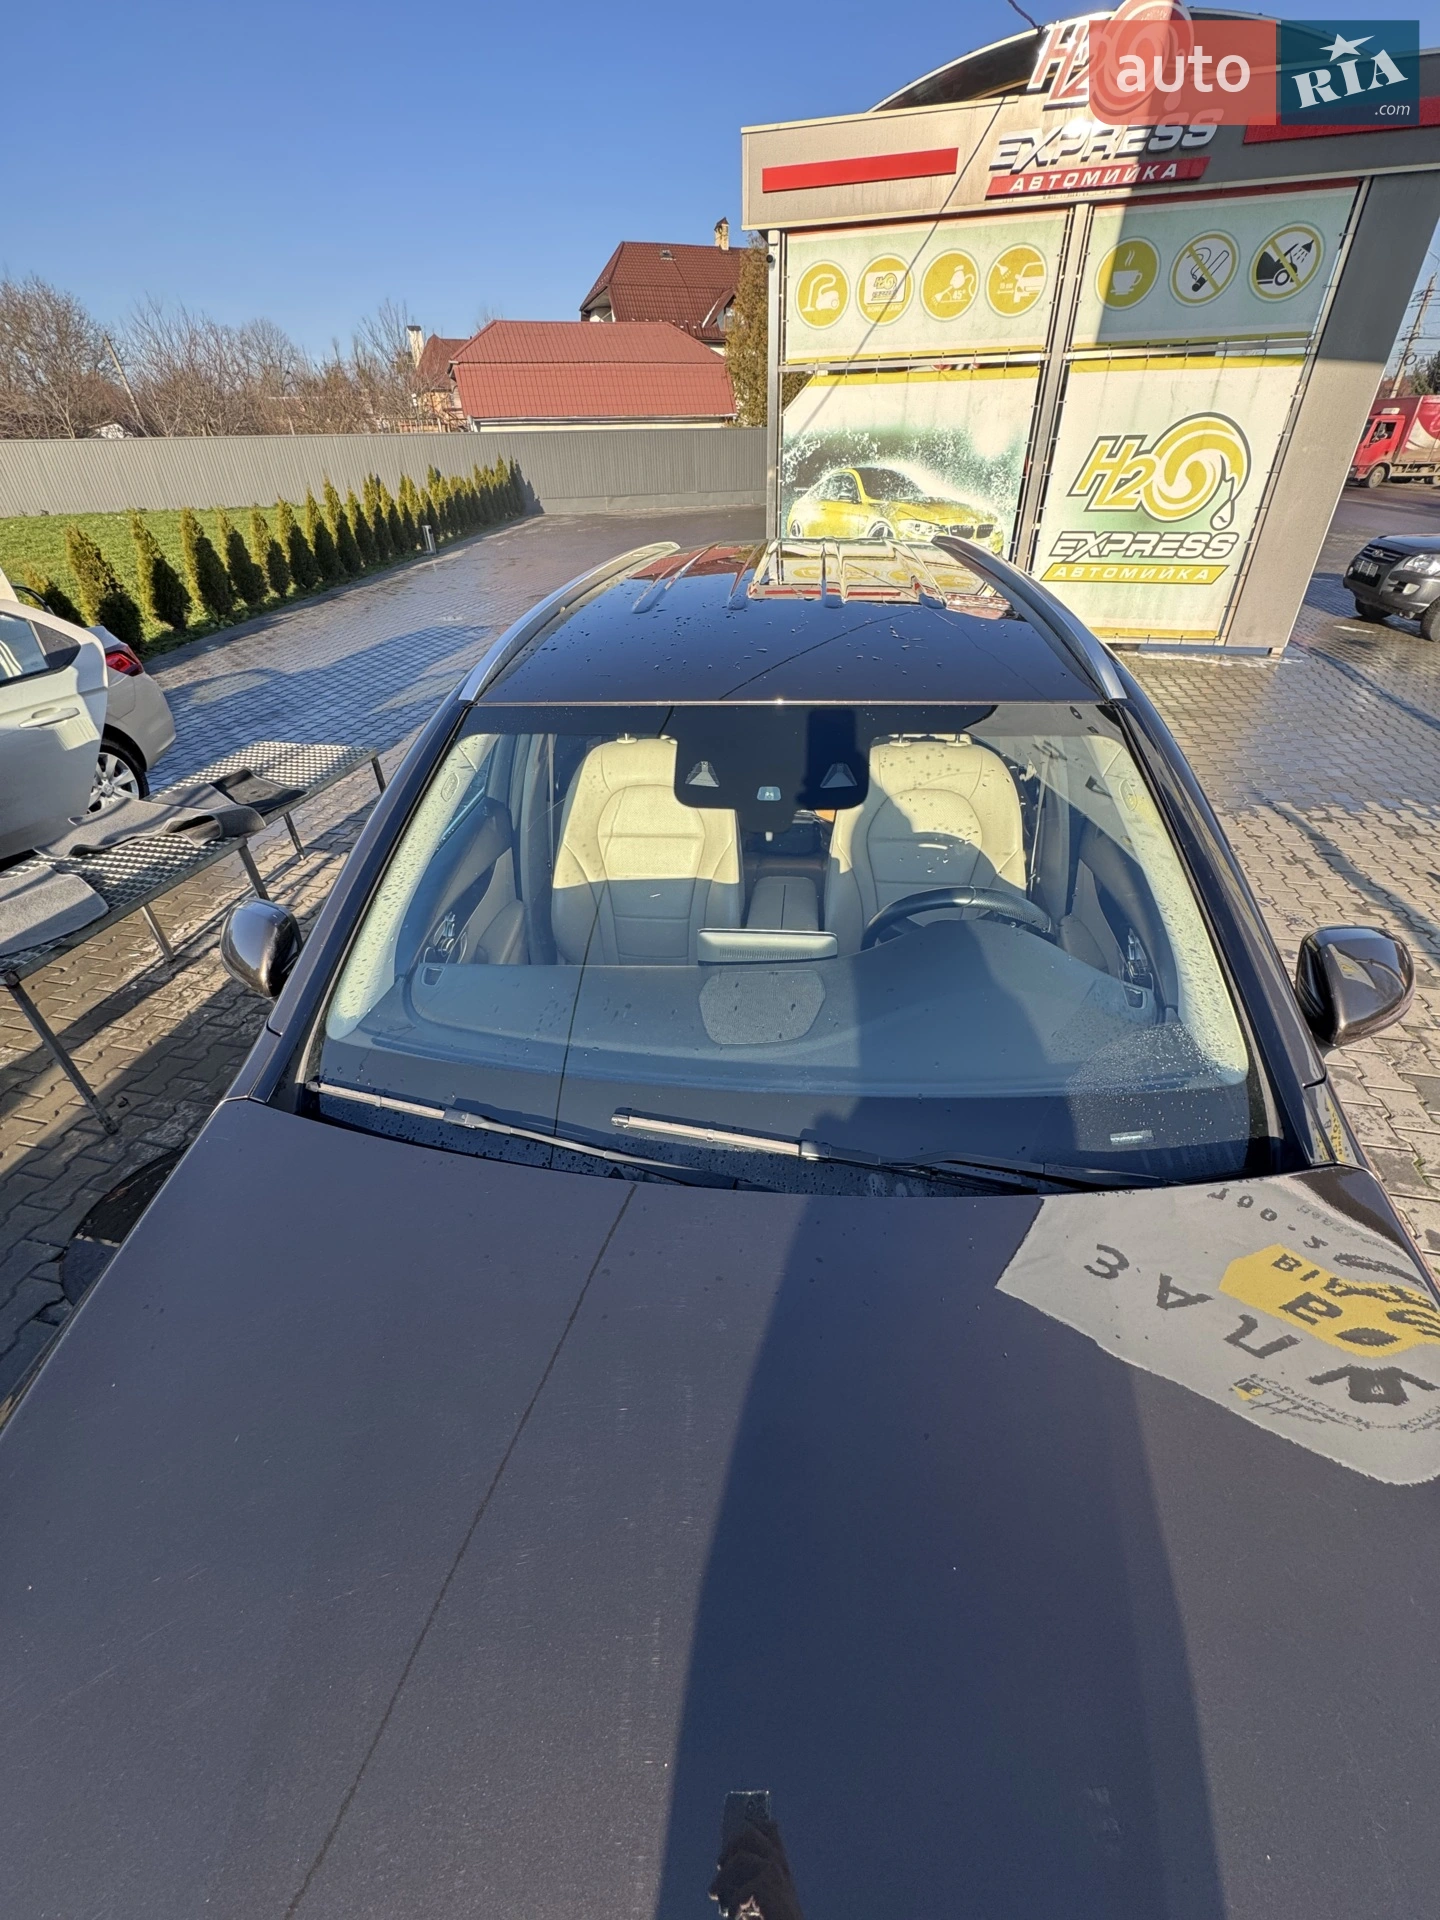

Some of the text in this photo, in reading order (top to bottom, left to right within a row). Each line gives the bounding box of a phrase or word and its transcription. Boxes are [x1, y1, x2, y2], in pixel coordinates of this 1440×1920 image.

[988, 108, 1225, 175] EXPRESS
[1009, 163, 1178, 193] АВТОМИЙКА
[1048, 531, 1240, 563] EXPRESS
[1053, 565, 1210, 581] АВТОМИЙКА
